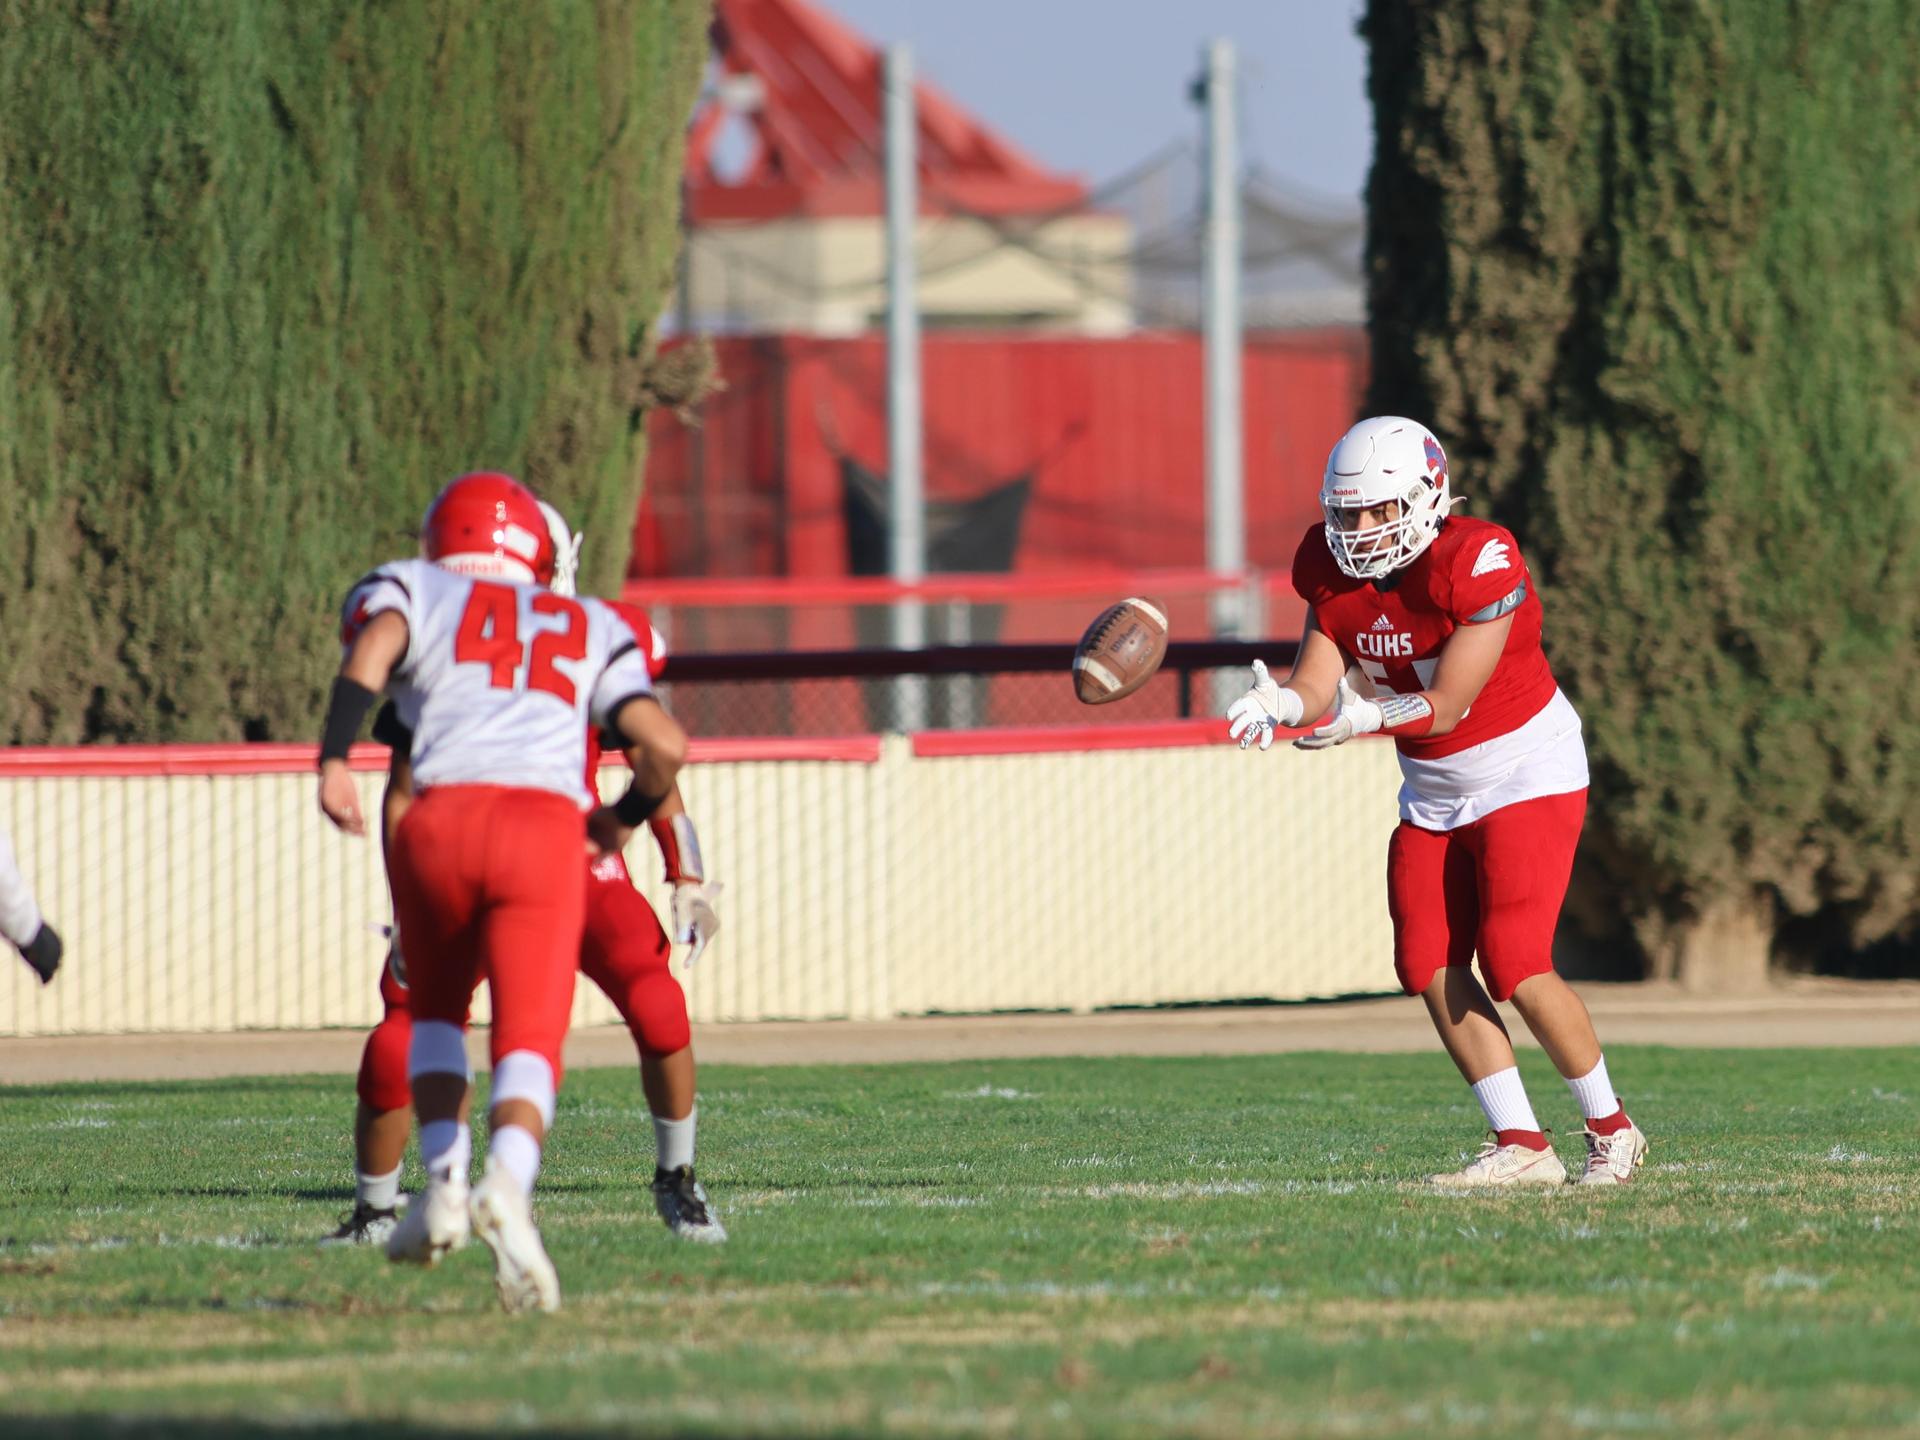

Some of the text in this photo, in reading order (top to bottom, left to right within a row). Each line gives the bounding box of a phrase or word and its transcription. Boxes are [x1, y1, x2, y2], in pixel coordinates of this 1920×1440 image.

[1371, 623, 1394, 631] adidas
[455, 582, 588, 706] 42
[1356, 632, 1414, 657] CUHS
